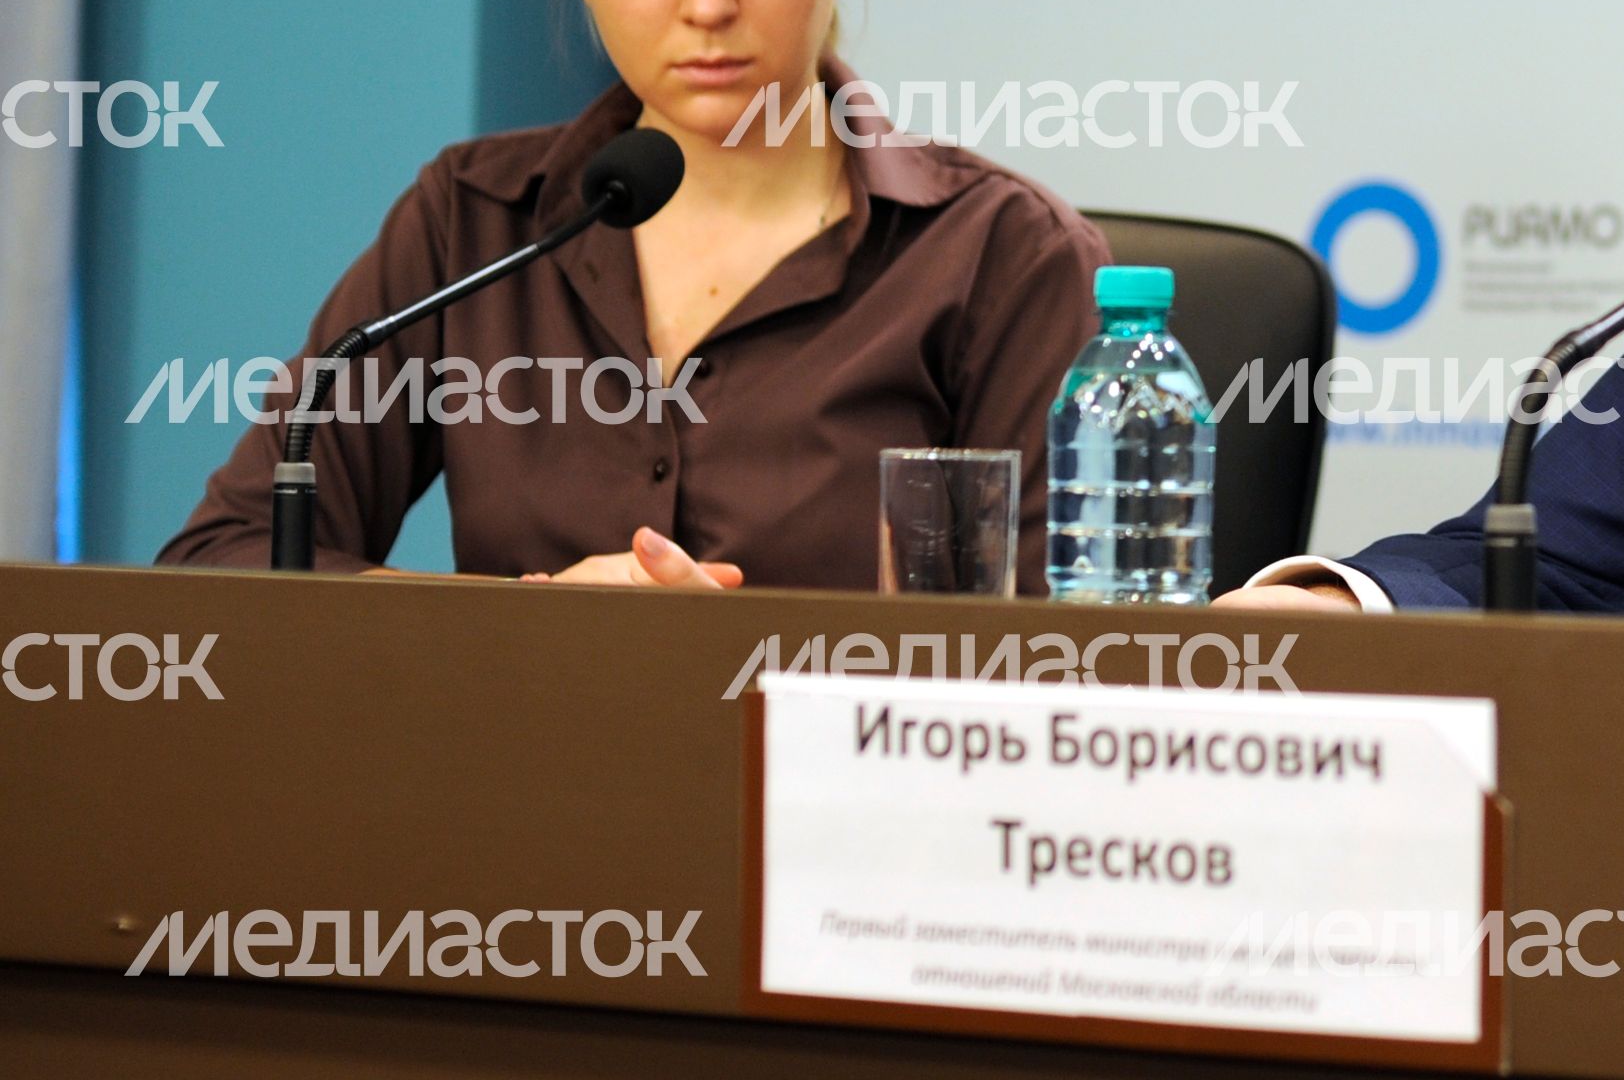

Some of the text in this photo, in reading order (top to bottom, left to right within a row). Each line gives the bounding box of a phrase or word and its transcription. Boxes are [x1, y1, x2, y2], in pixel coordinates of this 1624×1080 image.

[854, 703, 1384, 782] Игорь Борисович
[989, 818, 1236, 887] Тресков
